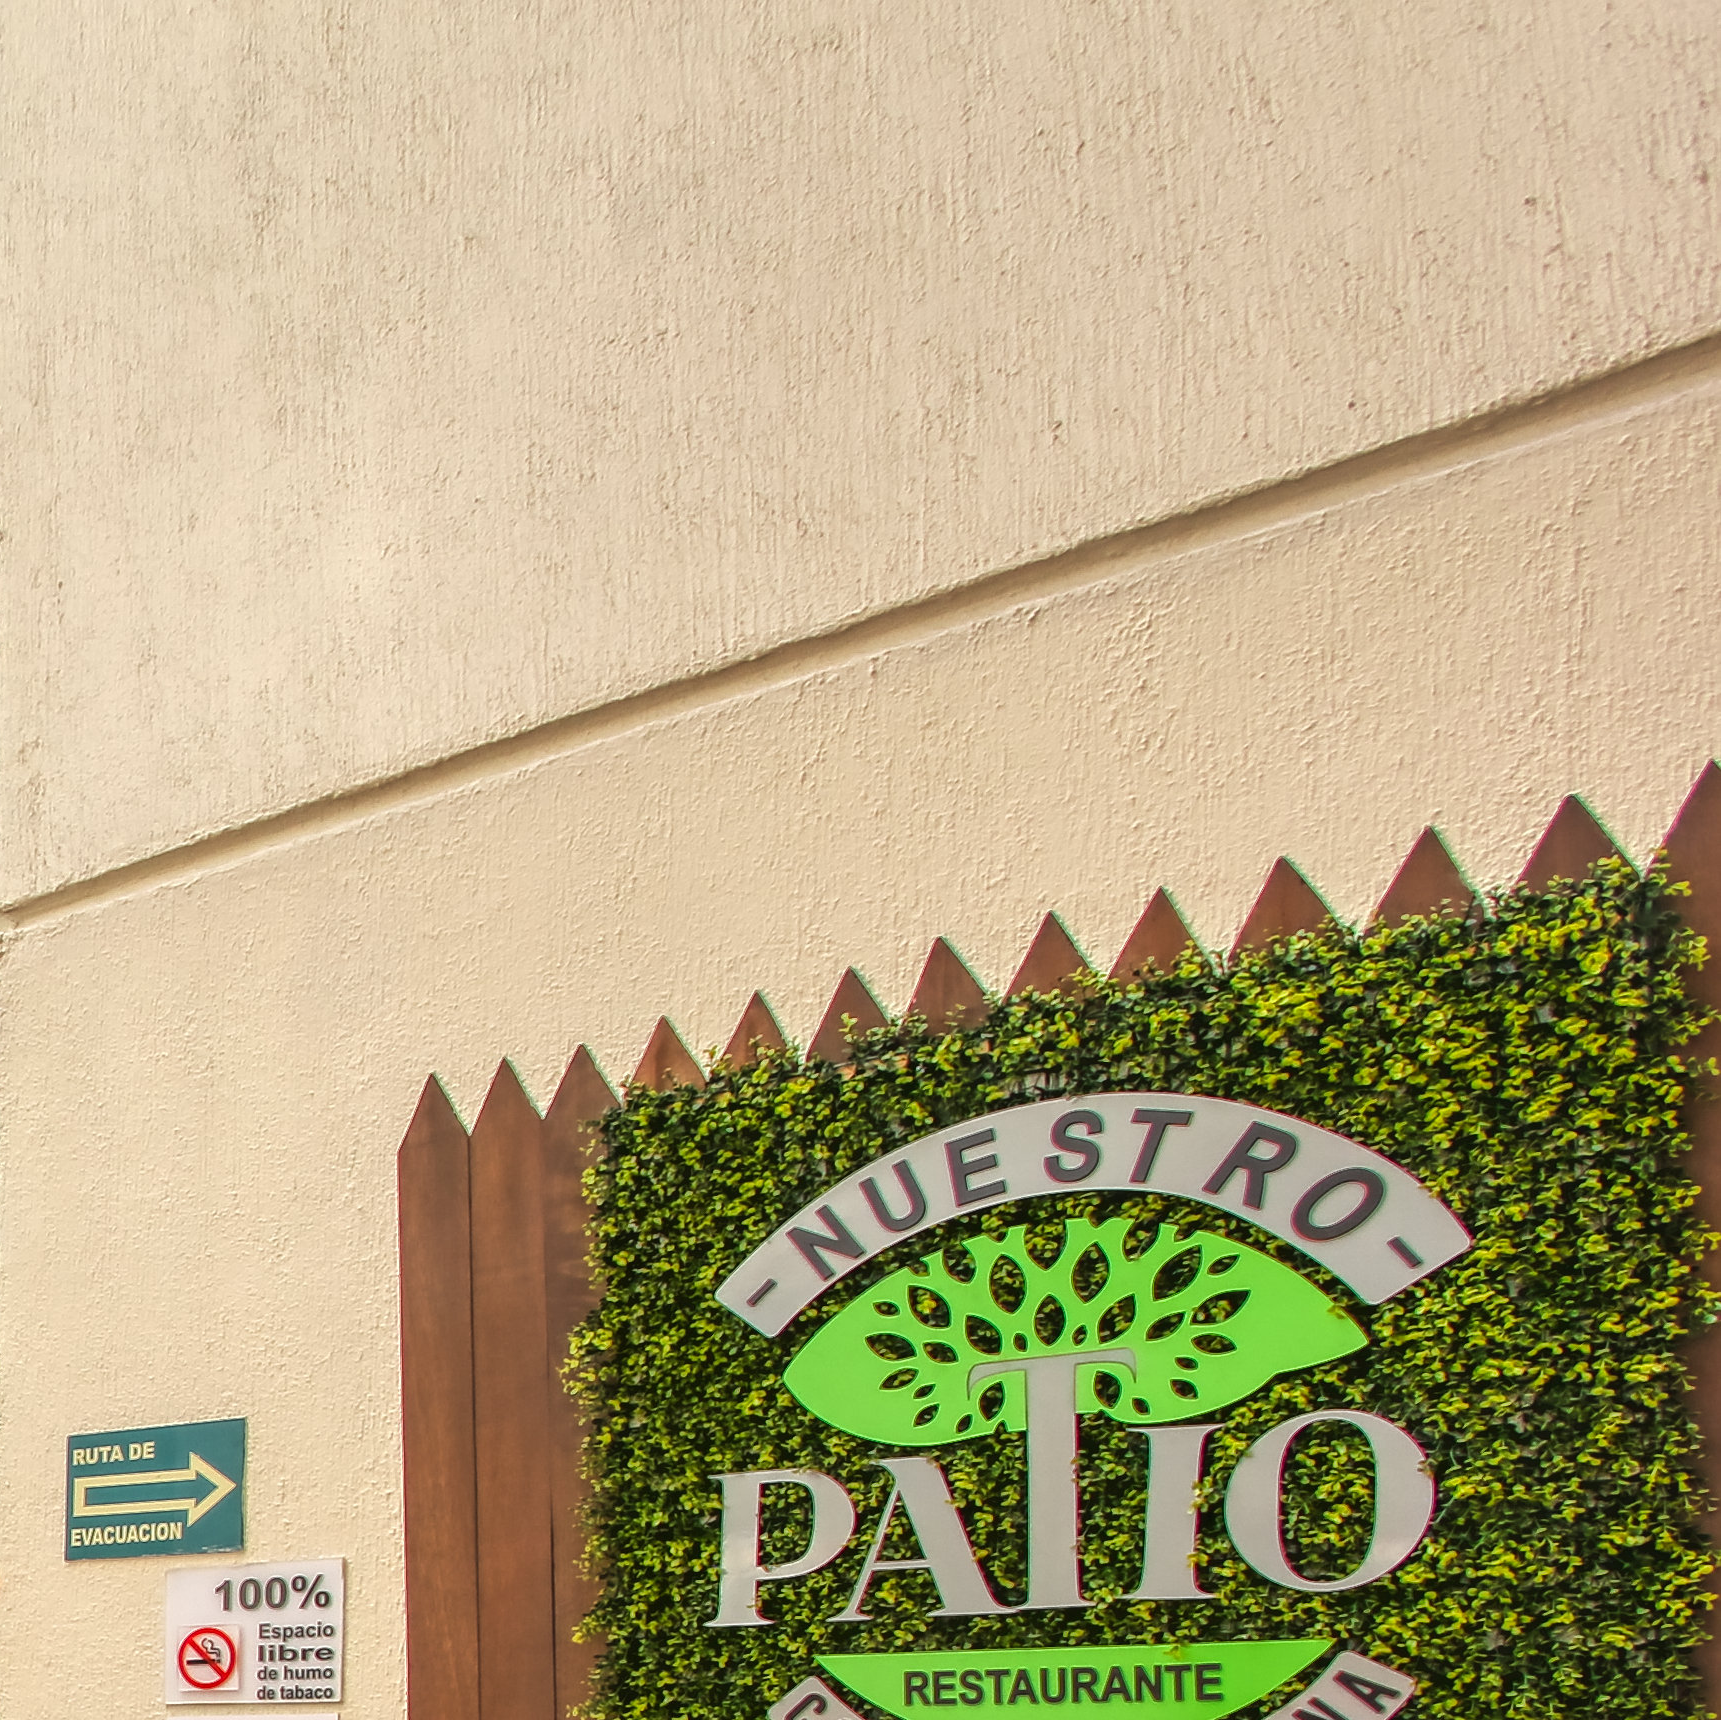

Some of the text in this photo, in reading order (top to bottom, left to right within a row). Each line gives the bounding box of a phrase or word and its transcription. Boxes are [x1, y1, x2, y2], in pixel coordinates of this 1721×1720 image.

[784, 1107, 1386, 1284] NUESTRO
[72, 1441, 155, 1466] RUTA DE
[705, 1348, 1436, 1627] PATIO
[71, 1522, 183, 1547] EVACUACION
[215, 1574, 330, 1612] 100%
[258, 1621, 334, 1642] Espacio
[257, 1645, 334, 1662] libre
[257, 1666, 333, 1681] de humo
[904, 1662, 1225, 1707] RESTAURANTE
[257, 1685, 333, 1700] de tabaco
